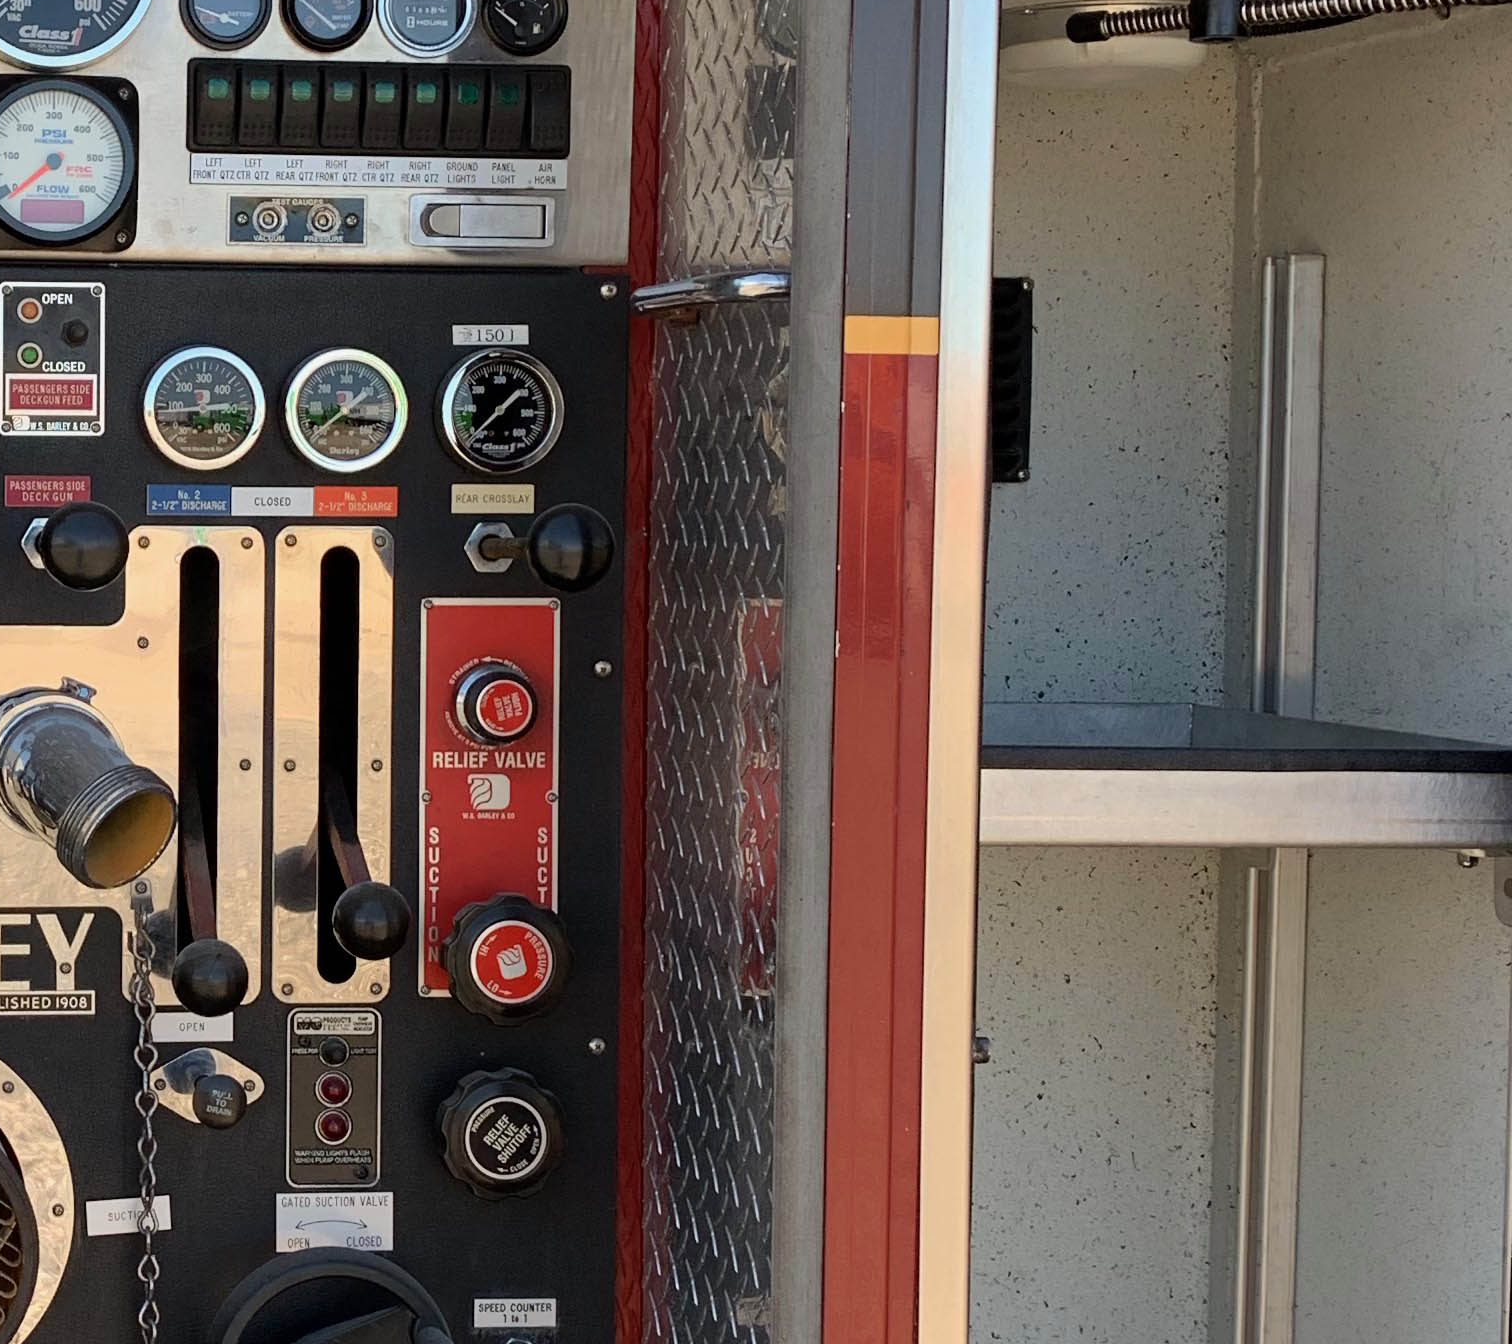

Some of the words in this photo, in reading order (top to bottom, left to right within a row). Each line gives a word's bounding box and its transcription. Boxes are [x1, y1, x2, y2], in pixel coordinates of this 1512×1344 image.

[446, 162, 479, 172] GROUND
[447, 174, 477, 184] LIGHTS
[41, 293, 74, 305] OPEN
[41, 361, 87, 373] CLOSED
[12, 383, 69, 394] PASSENGERS
[70, 384, 91, 395] SIDE
[19, 395, 61, 406] DECKGUN
[62, 395, 84, 406] FEED
[9, 480, 65, 492] PASSENGERS
[65, 481, 87, 492] SIDE
[22, 491, 50, 502] DECK
[53, 491, 74, 502] GUN
[254, 496, 292, 507] CLOSED
[455, 494, 479, 504] REAR
[482, 494, 532, 504] CROSSLAY
[432, 751, 489, 770] RELIEF
[494, 751, 547, 769] VALVE
[428, 826, 441, 964] SUCTION
[523, 930, 549, 981] PRESSURE
[55, 995, 89, 1010] 1908
[179, 1022, 206, 1032] OPEN
[482, 1113, 511, 1147] RELIEF
[491, 1122, 521, 1152] VALVE
[496, 1123, 532, 1164] SHUTOFF
[281, 1196, 312, 1208] GATED
[315, 1196, 356, 1208] SUCTION
[359, 1195, 389, 1207] VALVE
[287, 1237, 311, 1249] OPEN
[346, 1235, 382, 1248] CLOSED
[478, 1302, 507, 1314] SPEED
[509, 1302, 553, 1313] COUNTER
